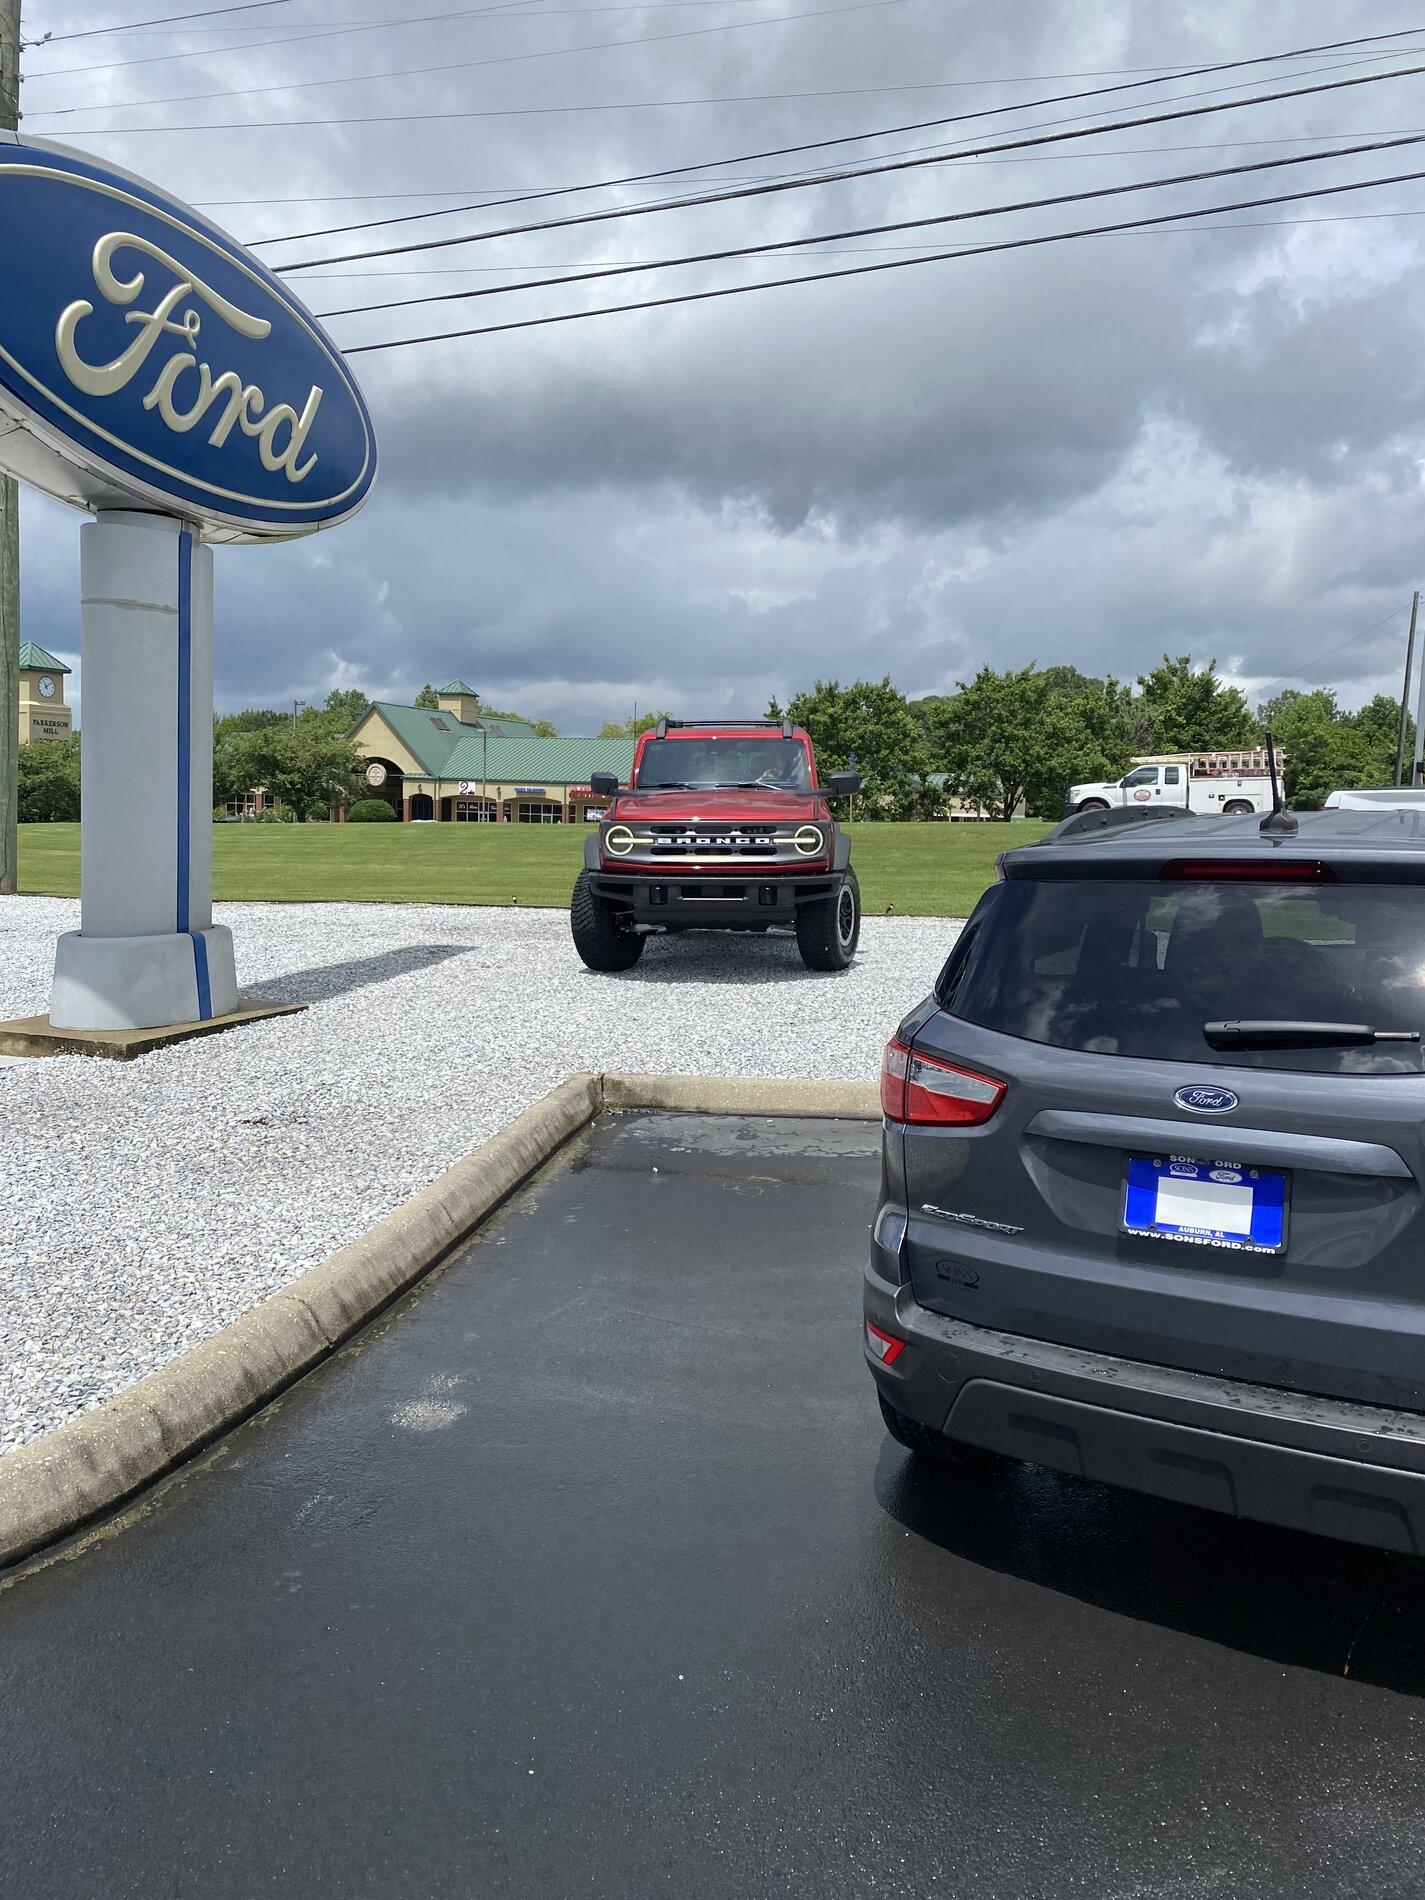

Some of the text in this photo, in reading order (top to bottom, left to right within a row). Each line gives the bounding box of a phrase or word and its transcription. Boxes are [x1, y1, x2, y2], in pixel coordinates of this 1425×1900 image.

[56, 231, 323, 484] Ford
[32, 719, 69, 728] PARKERSON
[43, 727, 59, 735] MILL
[657, 837, 770, 845] BRONCO
[1188, 1090, 1224, 1107] Ford
[1169, 1154, 1242, 1170] SON ORD
[1173, 1164, 1195, 1173] SONS
[1215, 1171, 1237, 1182] Ford
[1178, 1226, 1226, 1238] AUBURN, AL
[1127, 1228, 1276, 1255] www.SONSFORD.com
